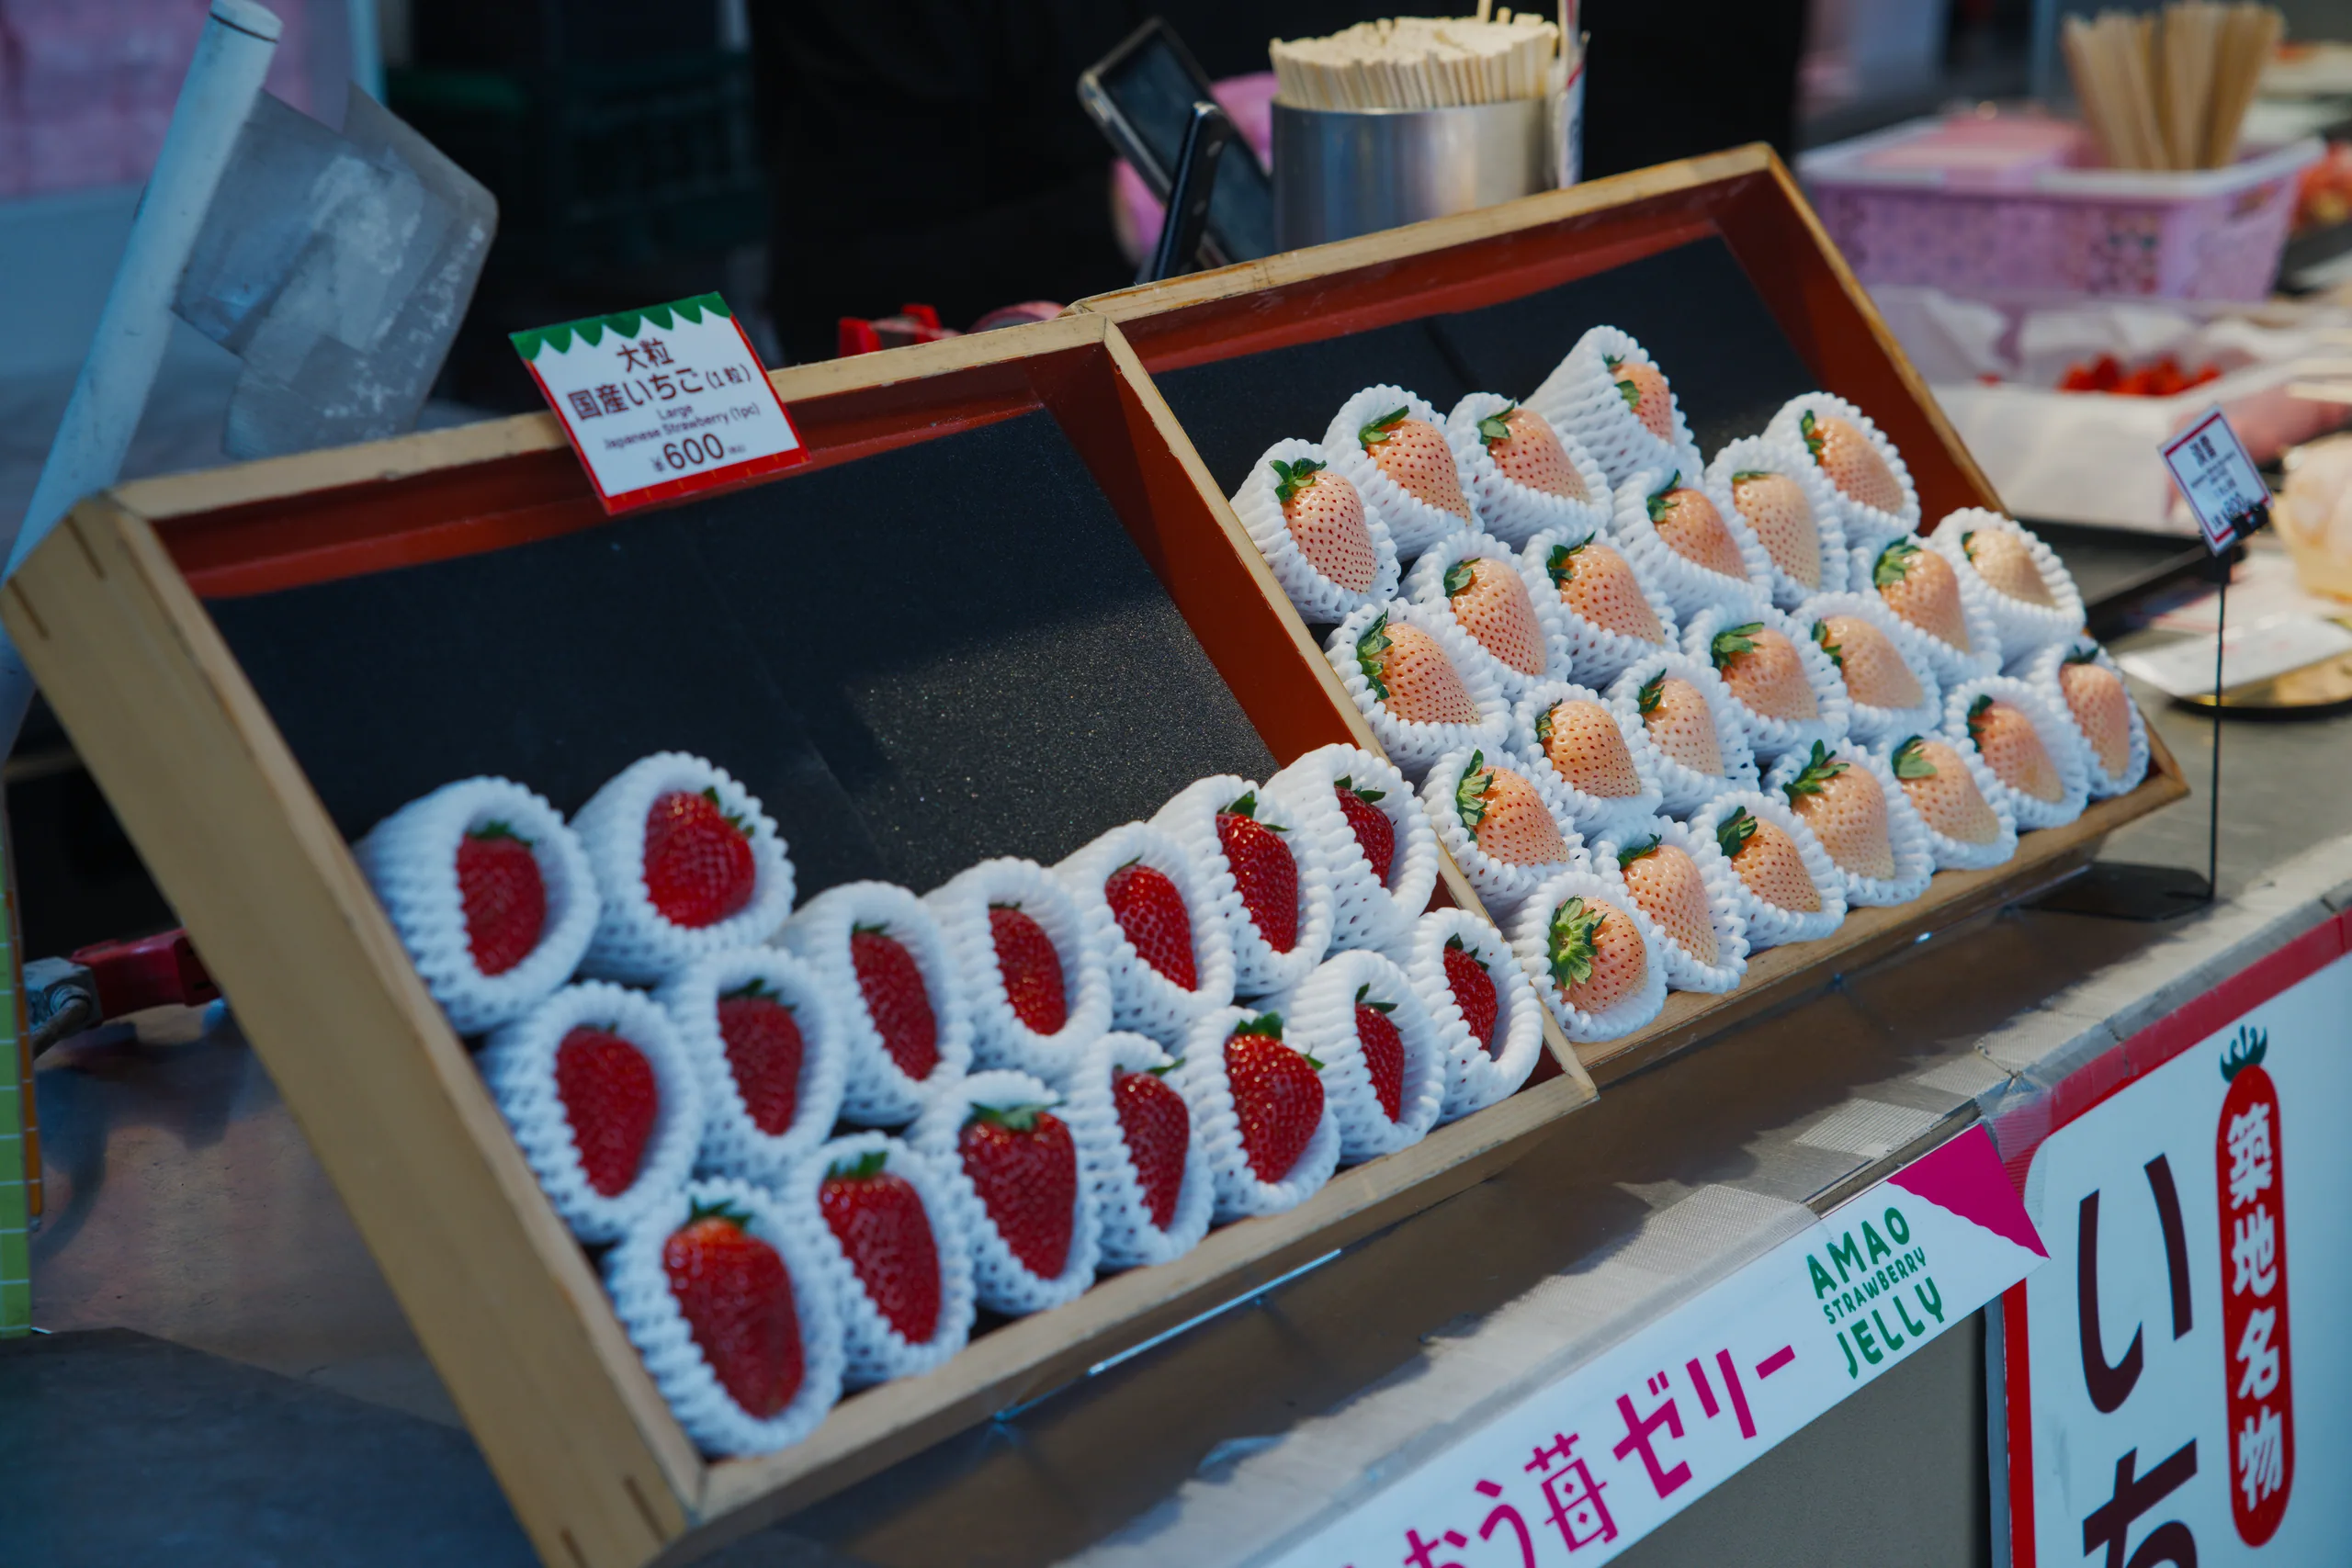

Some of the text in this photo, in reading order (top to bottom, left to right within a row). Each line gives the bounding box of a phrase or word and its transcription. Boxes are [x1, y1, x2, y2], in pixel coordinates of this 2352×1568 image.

[616, 338, 674, 373] 大粒
[604, 402, 762, 450] Japanese Strawberry (1pc)
[656, 405, 694, 420] Large
[1806, 1207, 1910, 1300] AMAO
[1823, 1246, 1928, 1325] STRAWBERRY
[1836, 1276, 1945, 1380] JELLY
[2226, 1102, 2285, 1513] 築地名物
